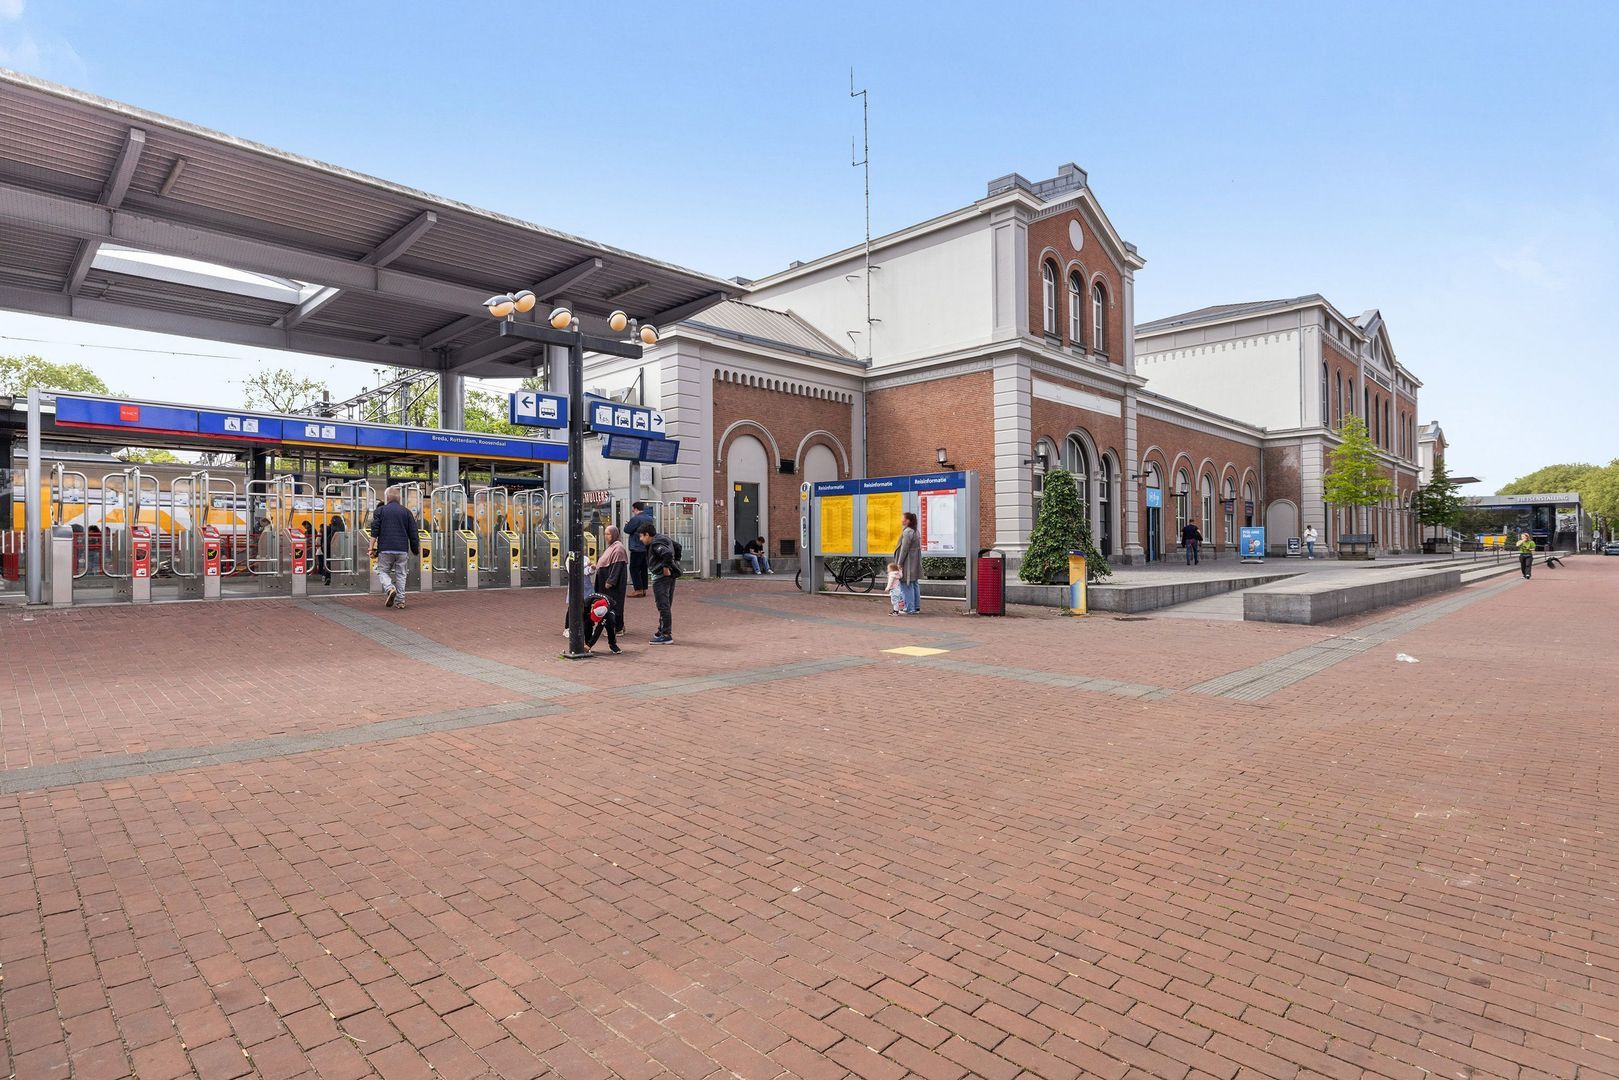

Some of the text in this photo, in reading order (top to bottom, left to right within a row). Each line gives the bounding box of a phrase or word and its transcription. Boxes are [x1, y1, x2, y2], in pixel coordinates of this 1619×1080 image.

[449, 436, 477, 444] Rotterdam,
[478, 439, 506, 447] Roosendaal
[863, 481, 893, 489] Reisinformatie
[914, 477, 946, 485] Reisinformatie
